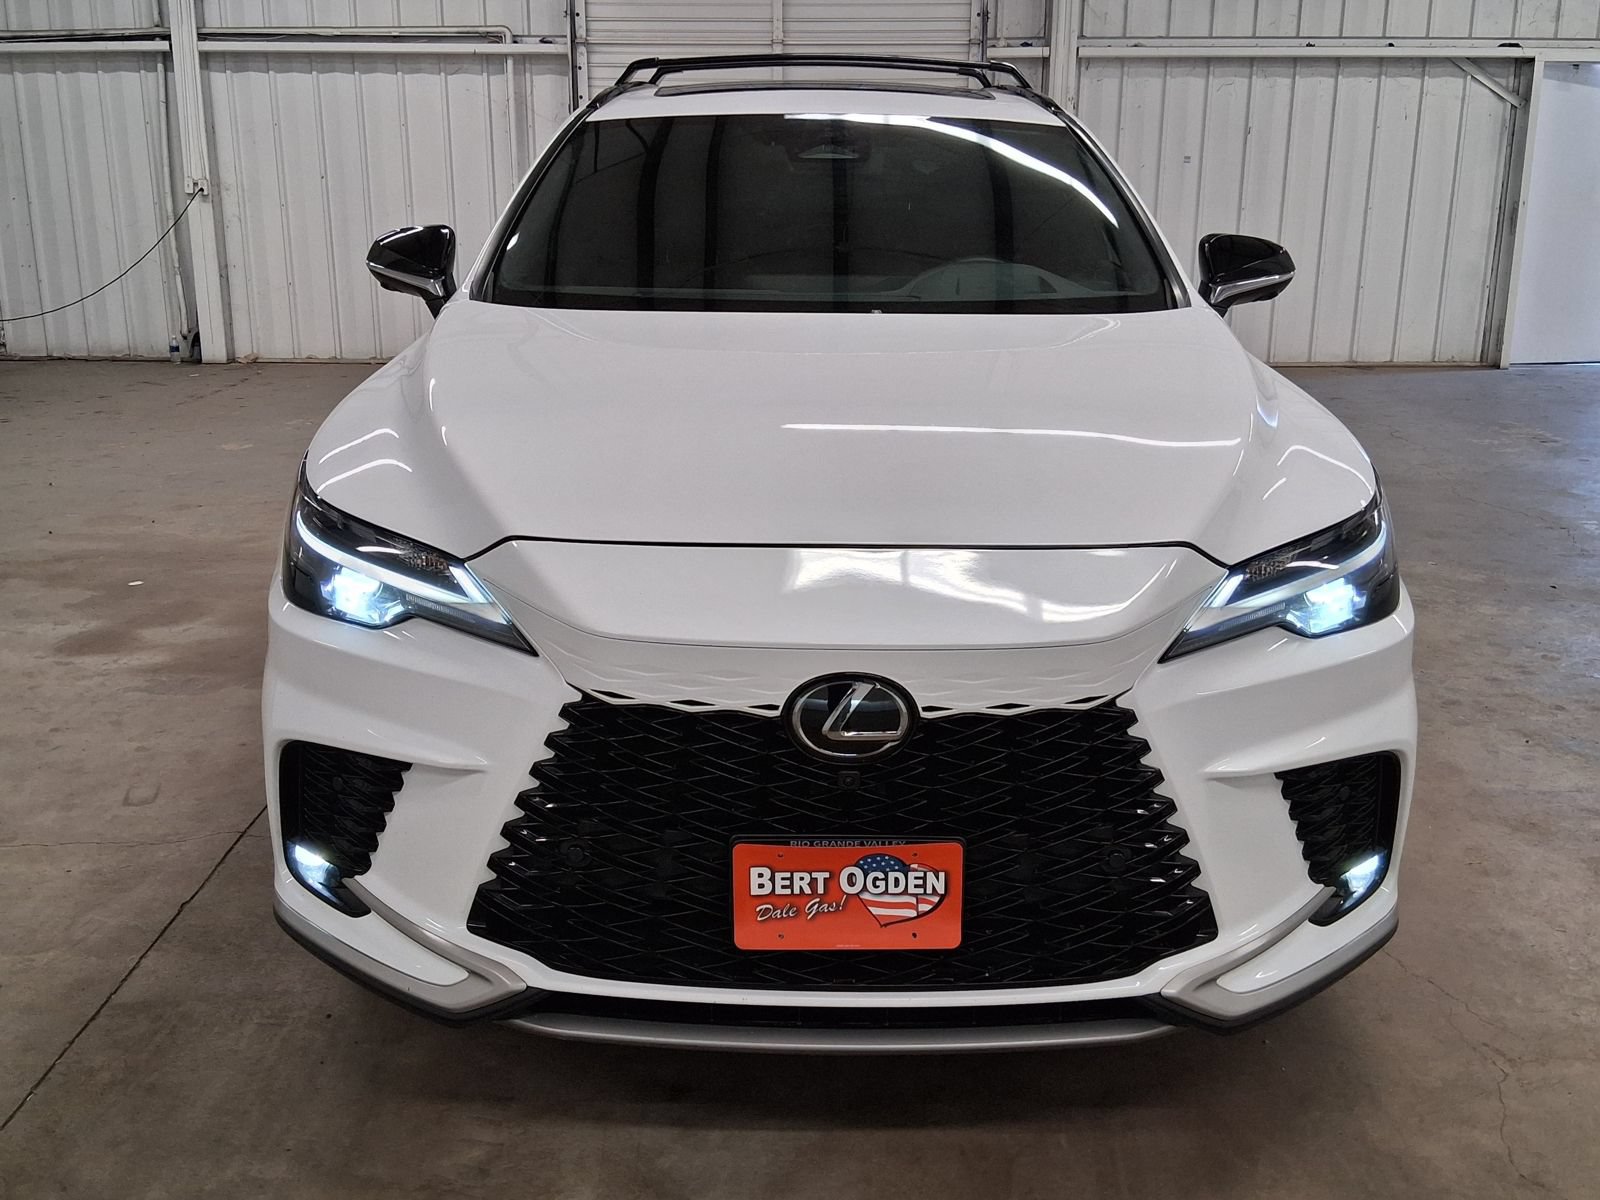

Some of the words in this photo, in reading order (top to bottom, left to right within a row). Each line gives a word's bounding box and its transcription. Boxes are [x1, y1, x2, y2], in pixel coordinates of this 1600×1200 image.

[790, 840, 810, 848] RIO
[813, 840, 861, 848] GRANDE
[749, 866, 830, 896] BERT
[839, 866, 946, 895] OGDEN
[756, 904, 798, 921] Dale
[805, 895, 847, 920] Gas!
